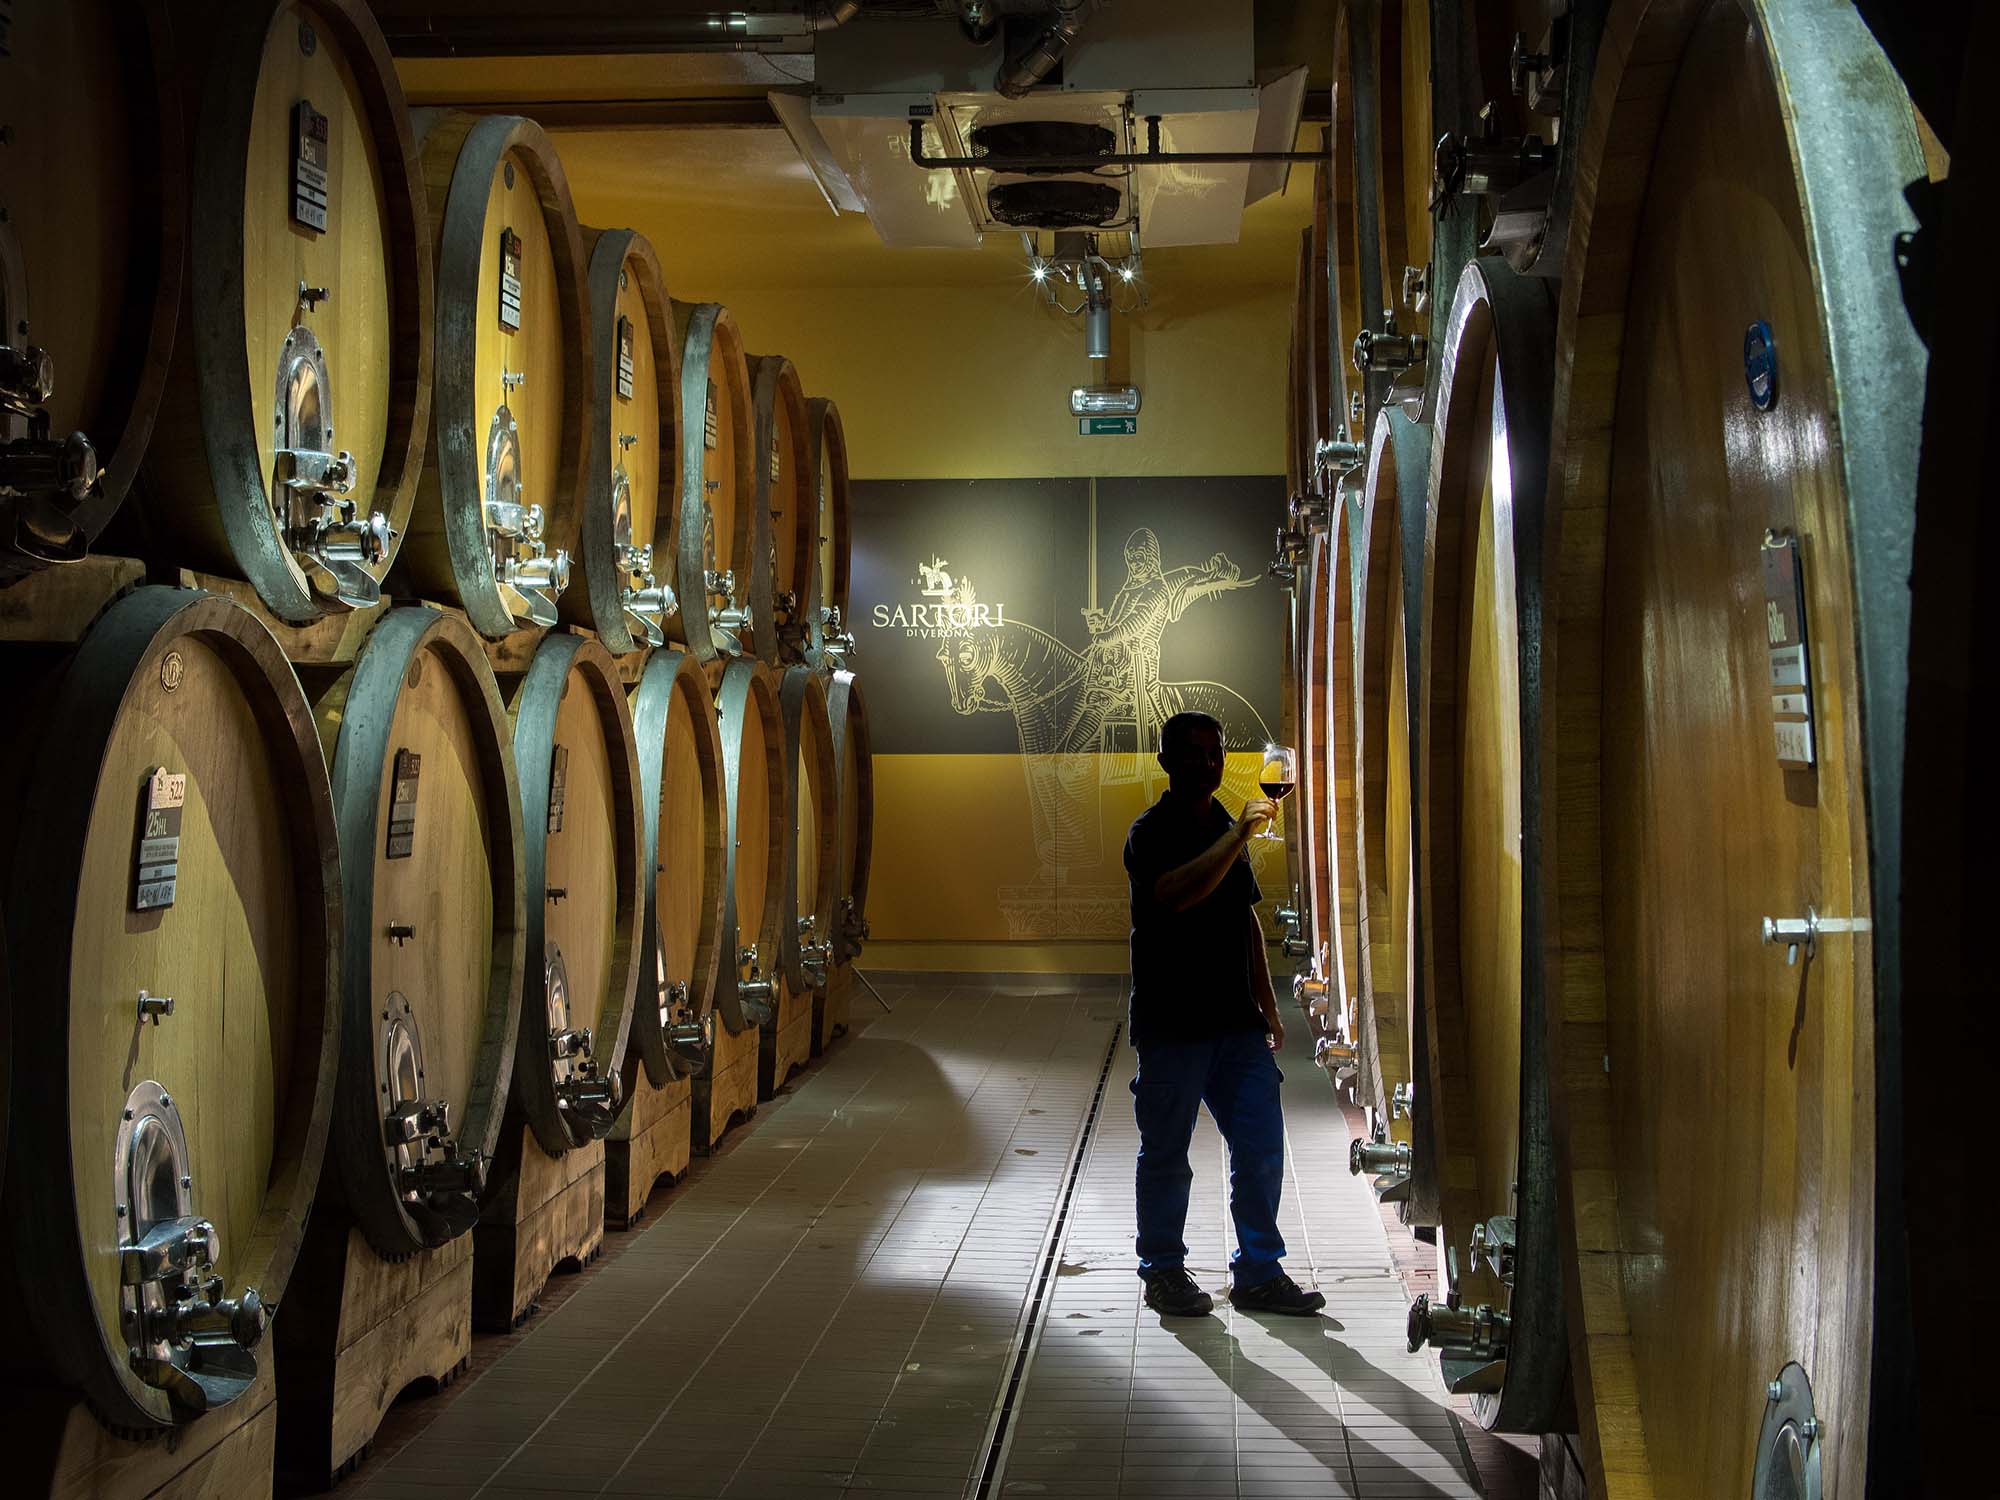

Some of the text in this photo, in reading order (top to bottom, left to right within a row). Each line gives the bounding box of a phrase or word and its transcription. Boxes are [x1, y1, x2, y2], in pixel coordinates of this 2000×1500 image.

[872, 603, 1005, 628] SARTORI
[906, 629, 970, 640] DI VERONA
[168, 780, 184, 801] 522
[147, 811, 167, 837] 25HL
